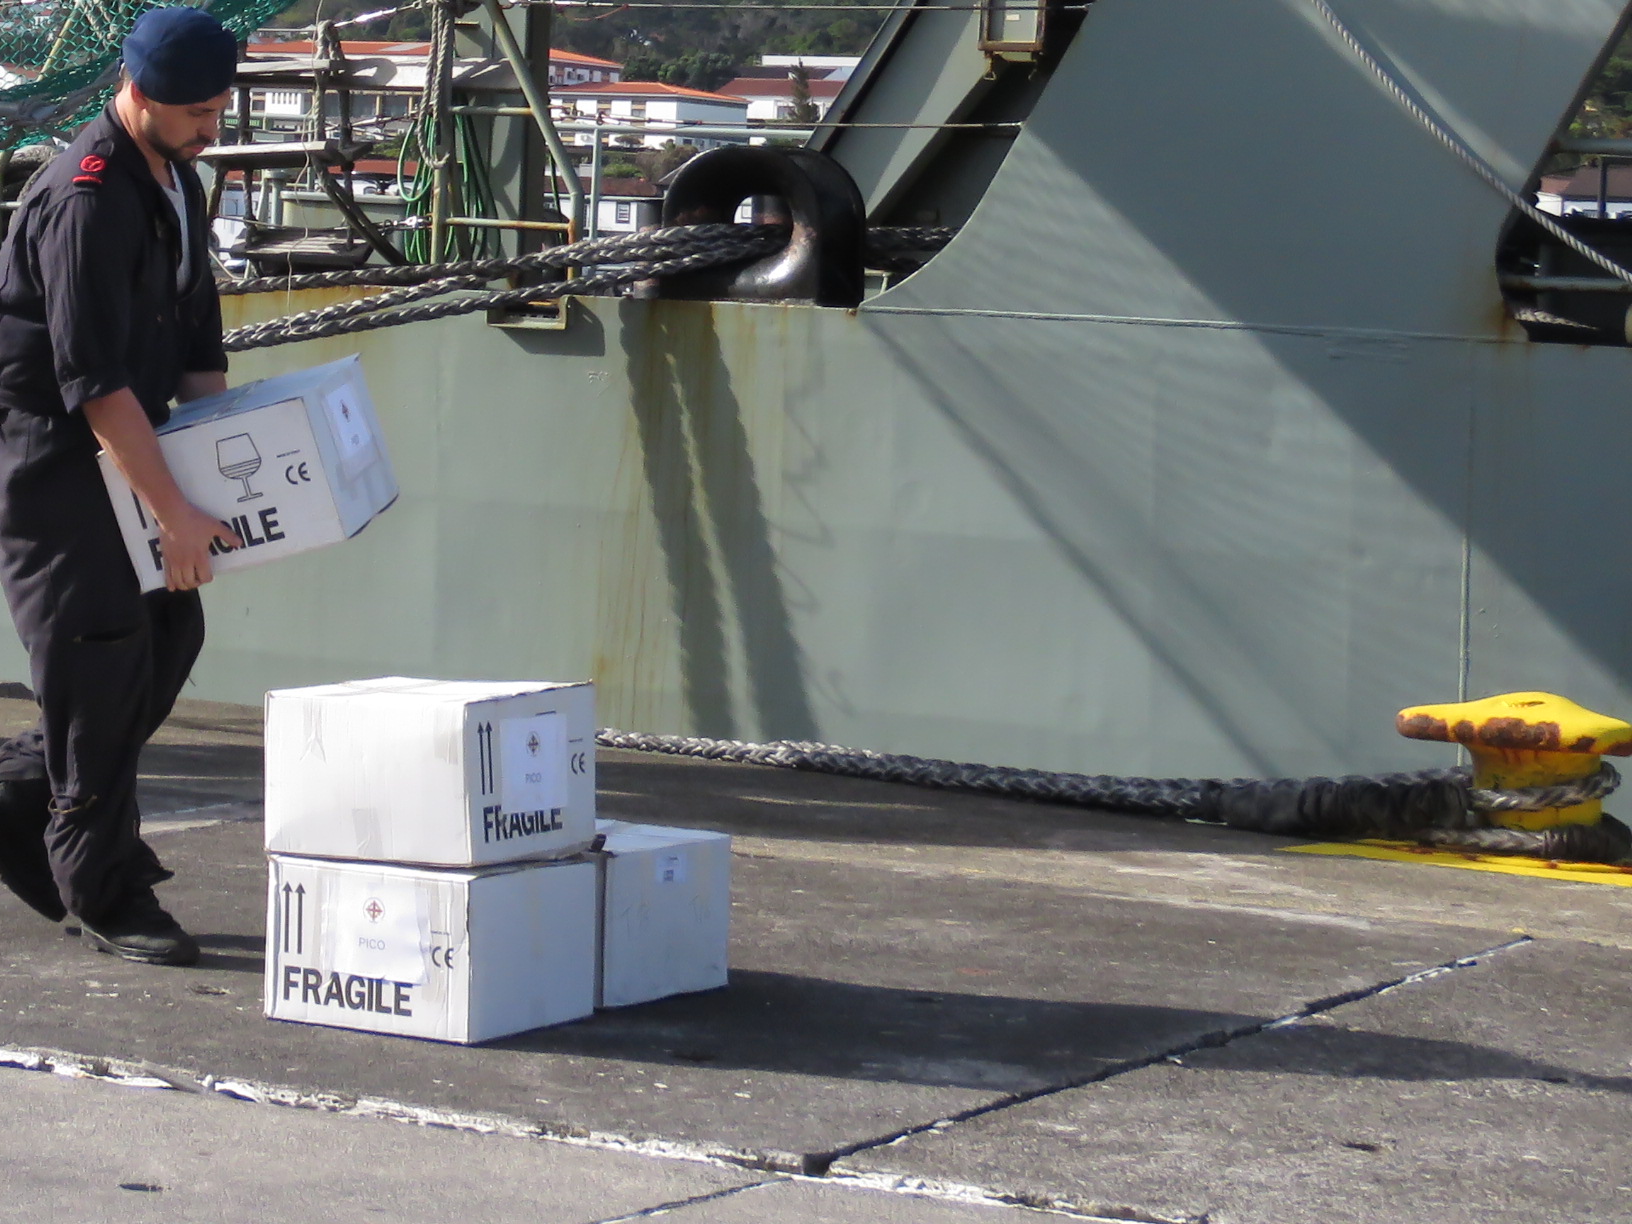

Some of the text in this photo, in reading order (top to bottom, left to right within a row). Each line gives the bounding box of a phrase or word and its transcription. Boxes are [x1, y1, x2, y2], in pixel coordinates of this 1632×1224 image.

[285, 462, 311, 485] CE
[571, 752, 586, 775] CE
[525, 772, 542, 784] PICO
[358, 936, 386, 951] PICO
[431, 945, 455, 970] CE
[283, 965, 414, 1018] FRAGILE
